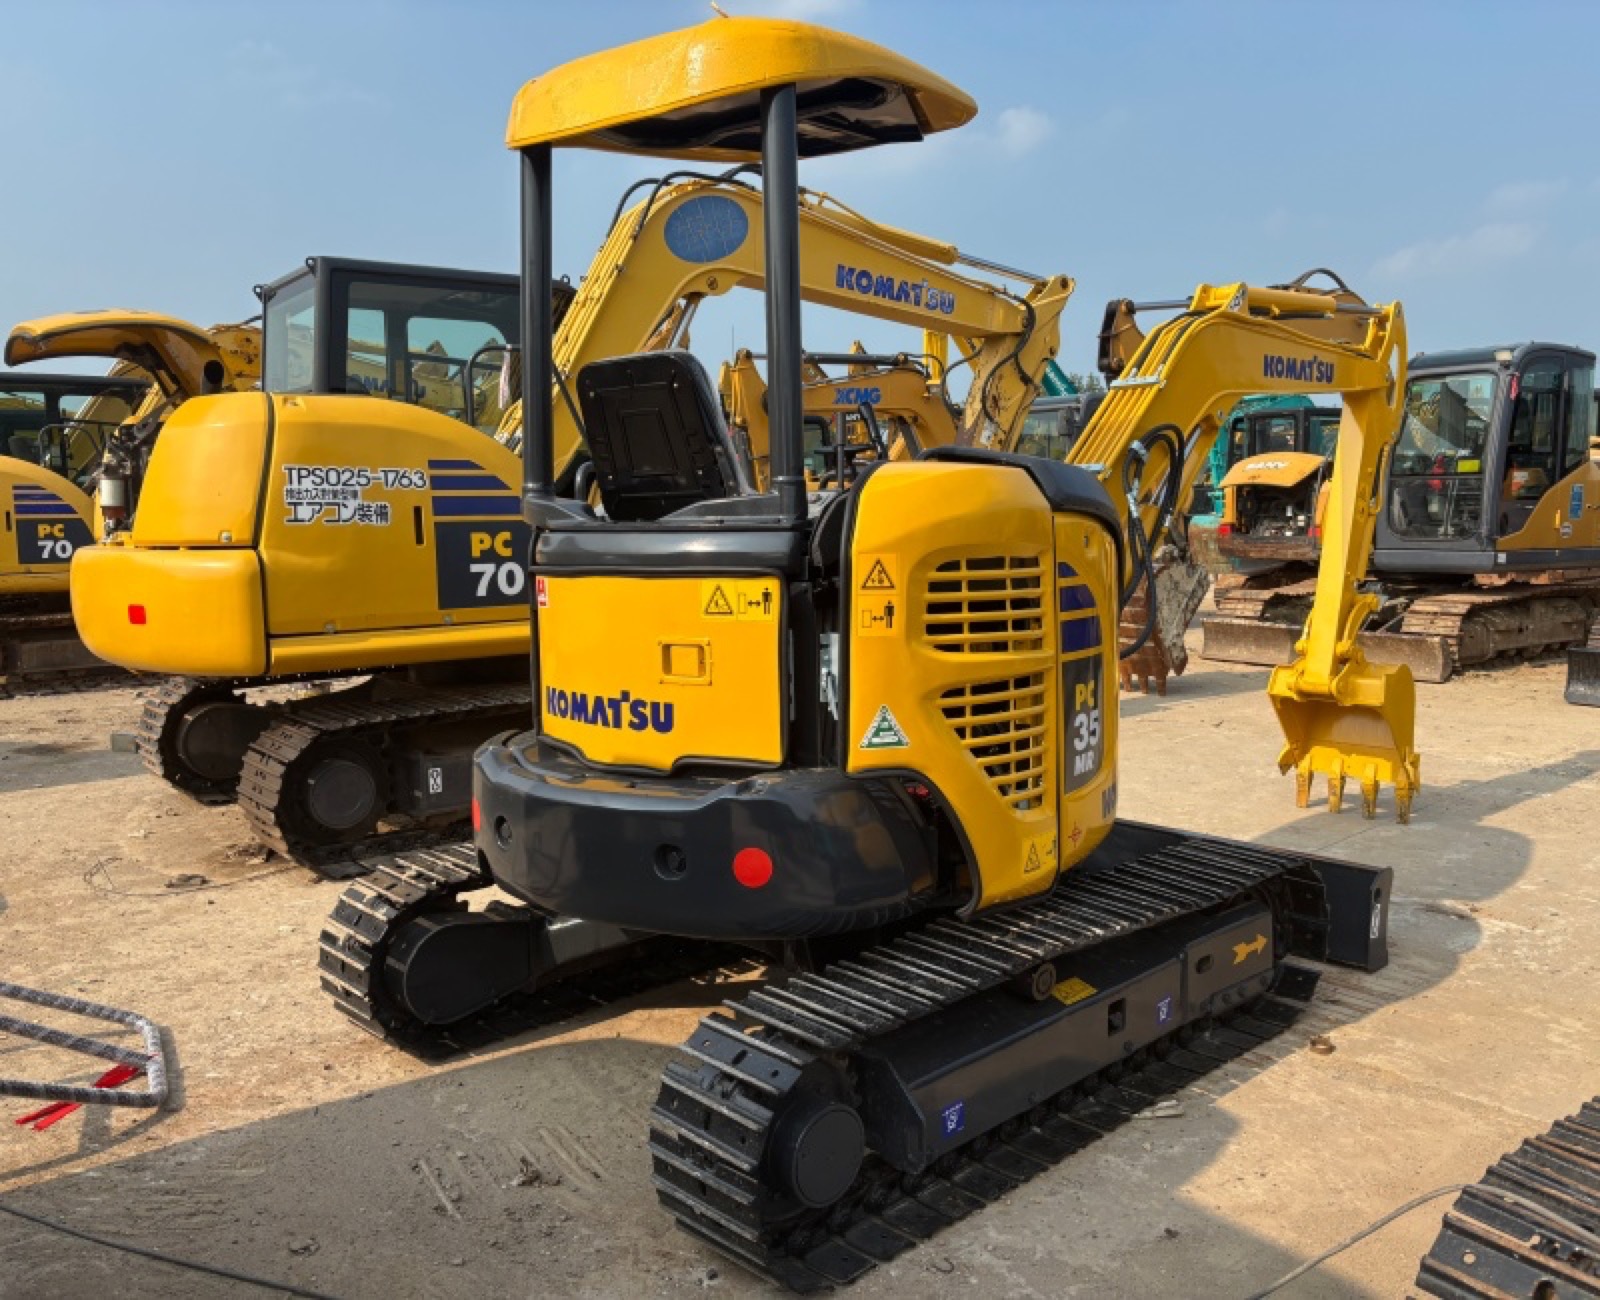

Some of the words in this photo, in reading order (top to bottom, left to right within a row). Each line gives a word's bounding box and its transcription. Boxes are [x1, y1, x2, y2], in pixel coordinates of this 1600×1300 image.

[836, 264, 955, 314] KOMATSU
[1263, 354, 1335, 384] KOMATSU
[832, 387, 881, 404] XCMG
[283, 466, 427, 489] TPS025-1763
[285, 501, 389, 524] エアコン装備
[37, 523, 65, 538] PC
[37, 540, 73, 558] 70
[470, 532, 512, 558] PC
[470, 562, 525, 596] 70
[1075, 680, 1095, 710] PC
[546, 685, 674, 733] KOMATSU
[1073, 709, 1099, 750] 35
[1074, 750, 1094, 776] MR
